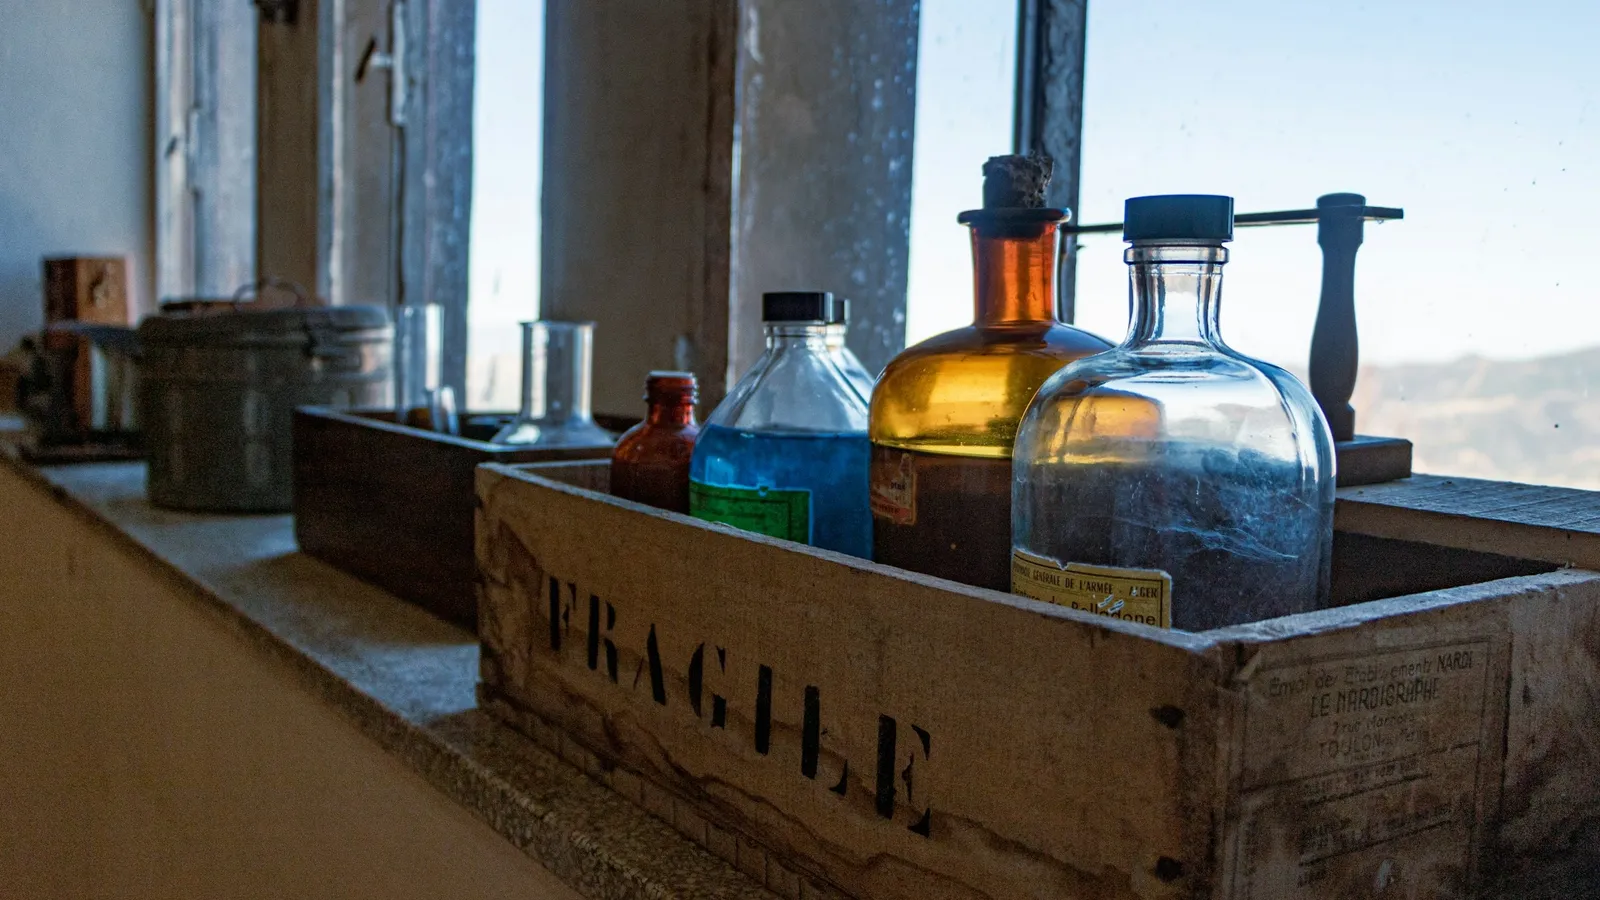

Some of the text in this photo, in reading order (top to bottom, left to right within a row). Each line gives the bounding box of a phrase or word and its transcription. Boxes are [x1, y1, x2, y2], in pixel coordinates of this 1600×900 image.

[1064, 577, 1075, 589] DE
[1437, 650, 1474, 675] NARDI
[548, 577, 931, 838] FRAGILE
[1310, 677, 1441, 719] LE NARDIGRAPHE
